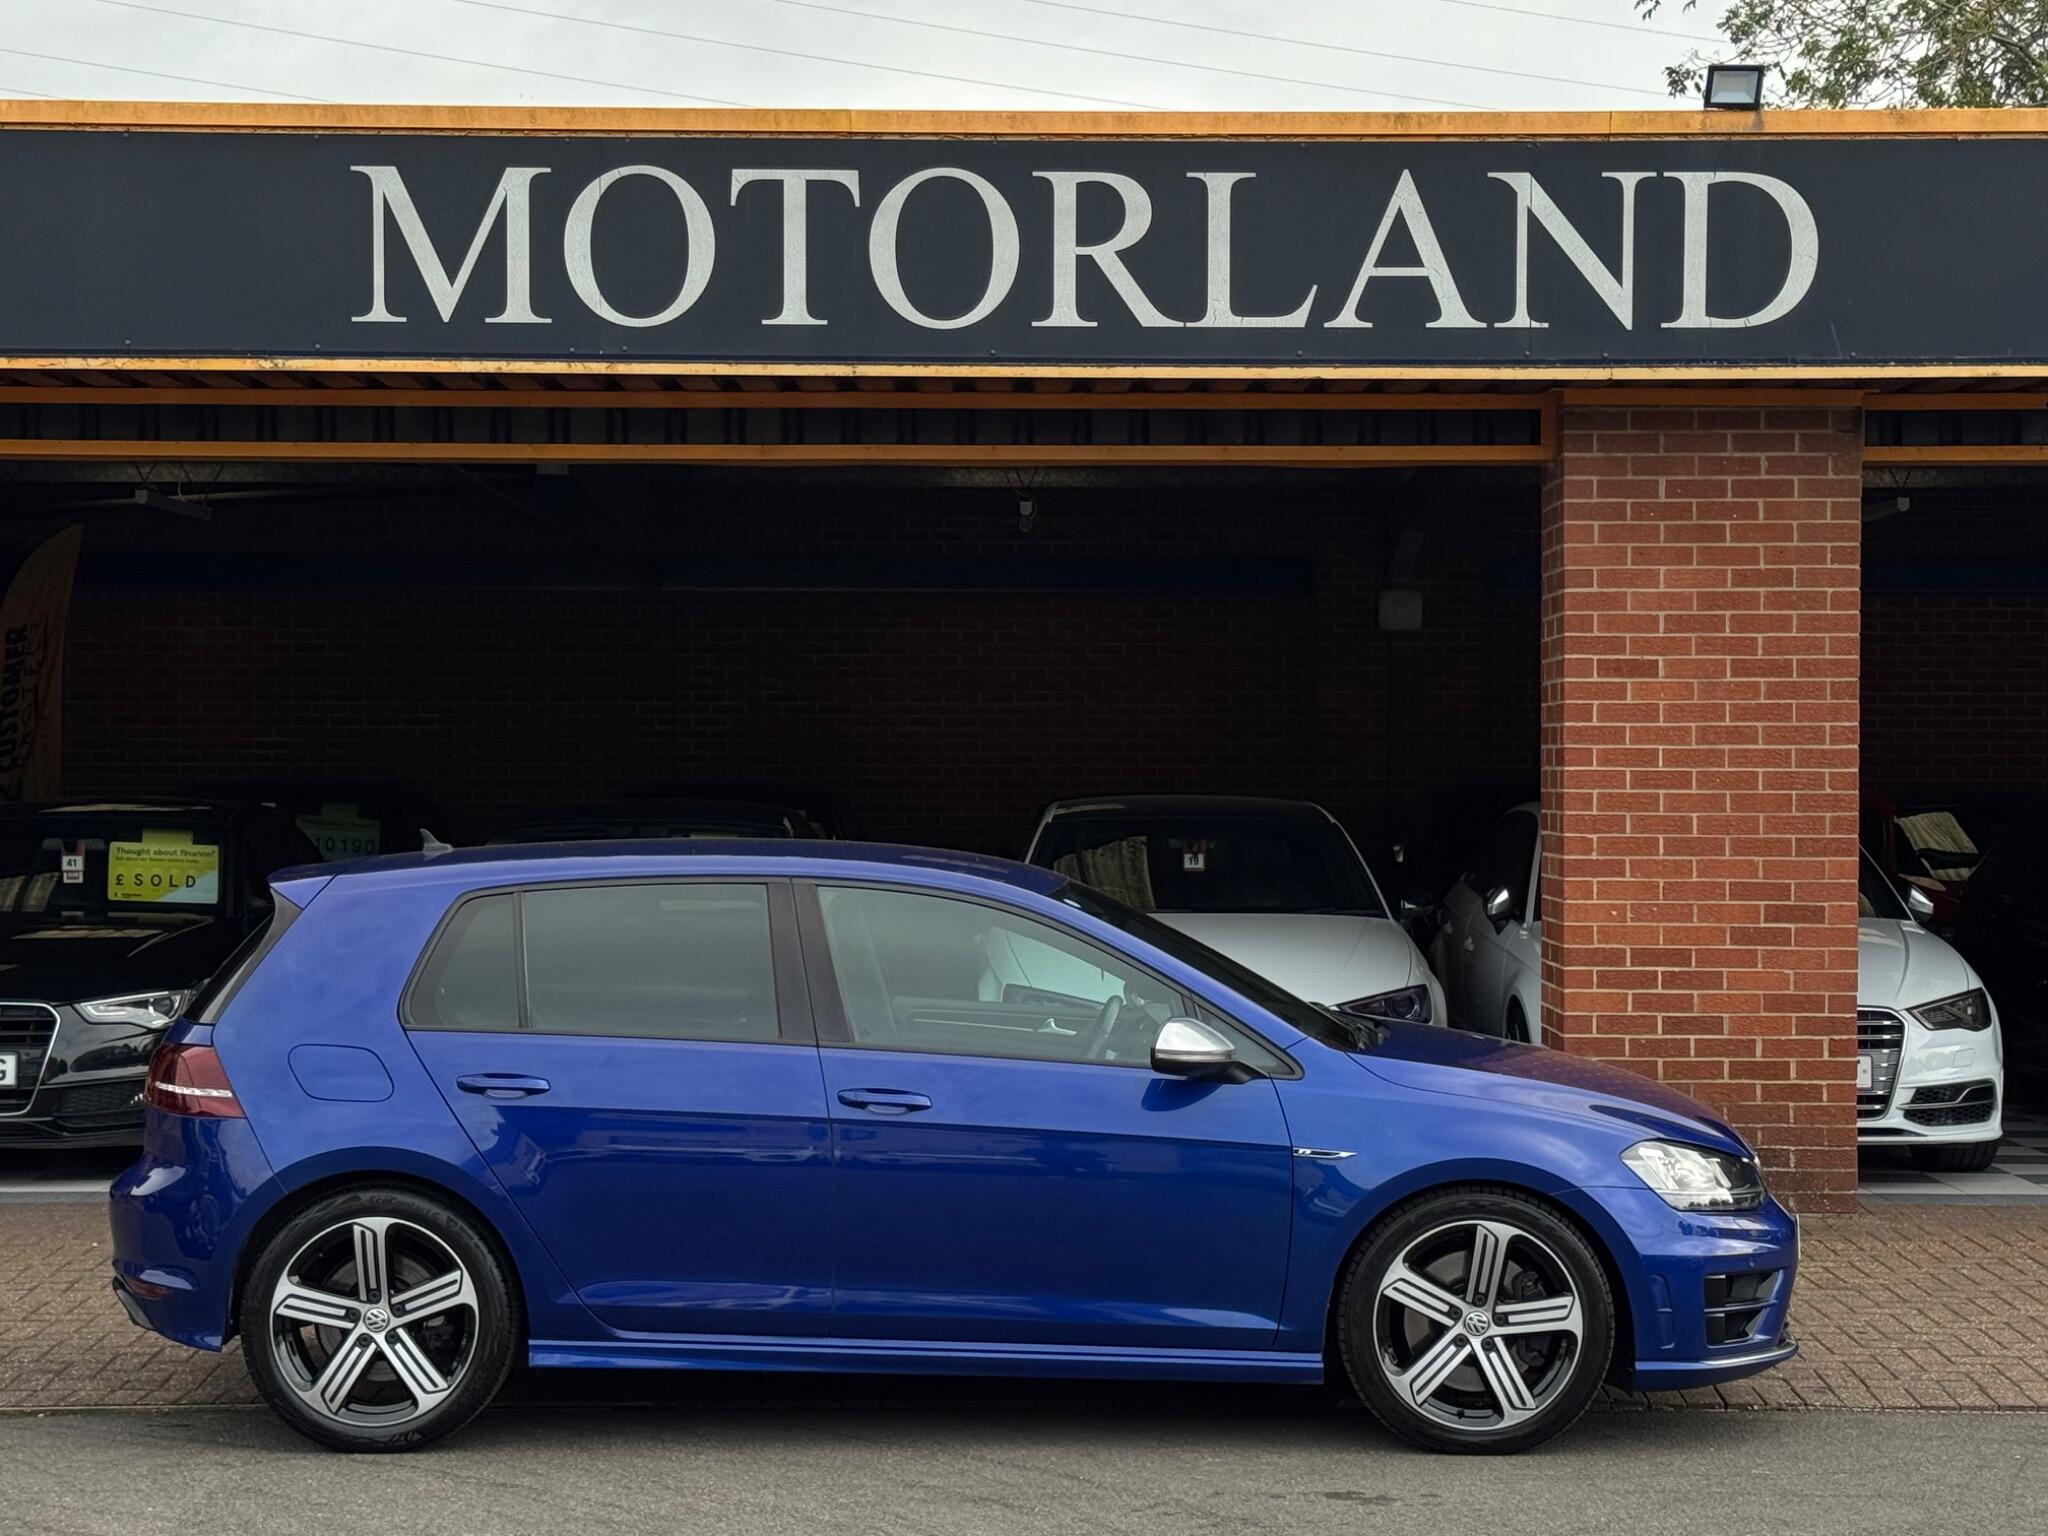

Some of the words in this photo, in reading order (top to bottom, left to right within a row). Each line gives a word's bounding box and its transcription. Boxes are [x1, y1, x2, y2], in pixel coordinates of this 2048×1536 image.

[351, 165, 1818, 330] MOTORLAND
[0, 624, 28, 774] CUSTOMER
[116, 847, 150, 856] Thought
[153, 848, 177, 856] about
[180, 849, 216, 857] finance?
[67, 858, 77, 867] 41
[115, 873, 125, 886] £
[134, 873, 196, 888] SOLD
